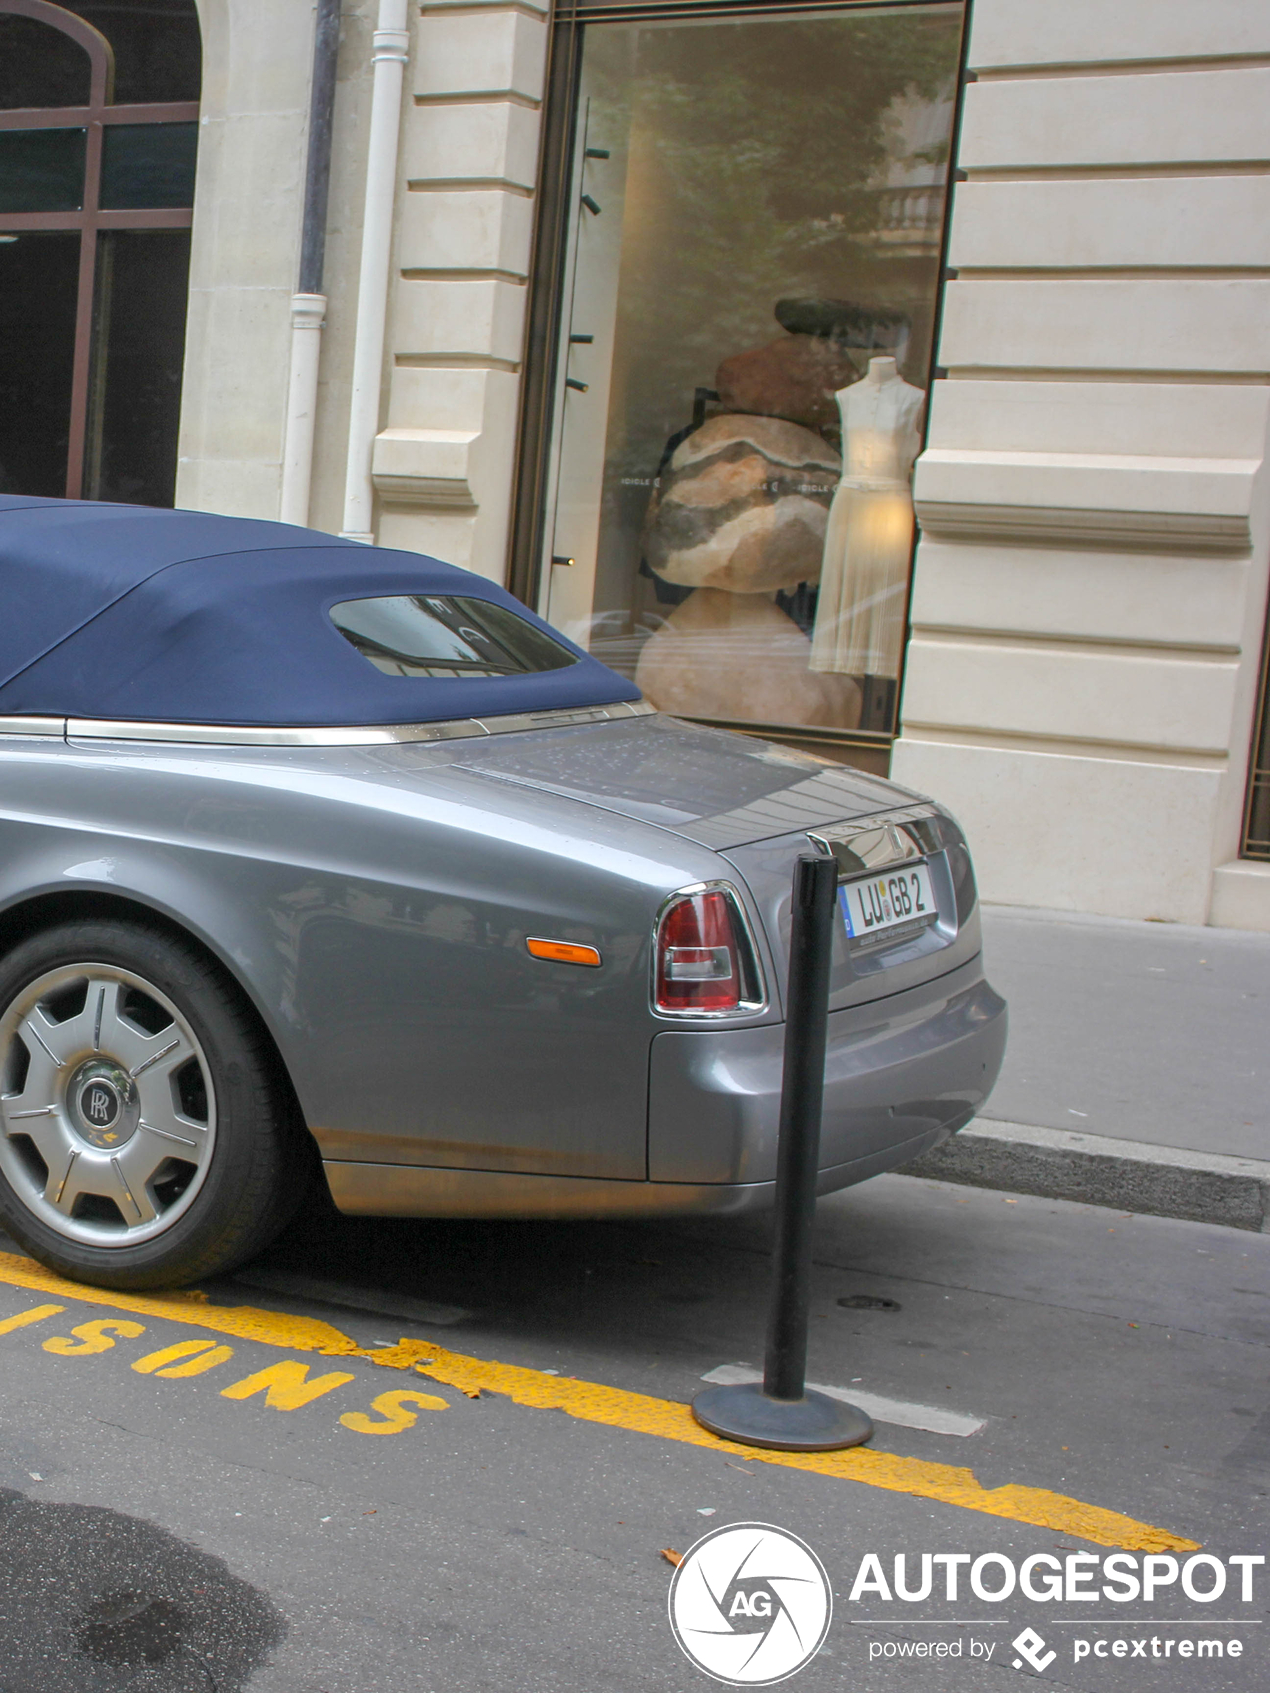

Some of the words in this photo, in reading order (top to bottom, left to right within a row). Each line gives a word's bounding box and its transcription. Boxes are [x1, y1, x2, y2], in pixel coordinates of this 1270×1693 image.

[857, 883, 884, 927] LU
[888, 876, 912, 918] GB
[911, 872, 925, 912] 2
